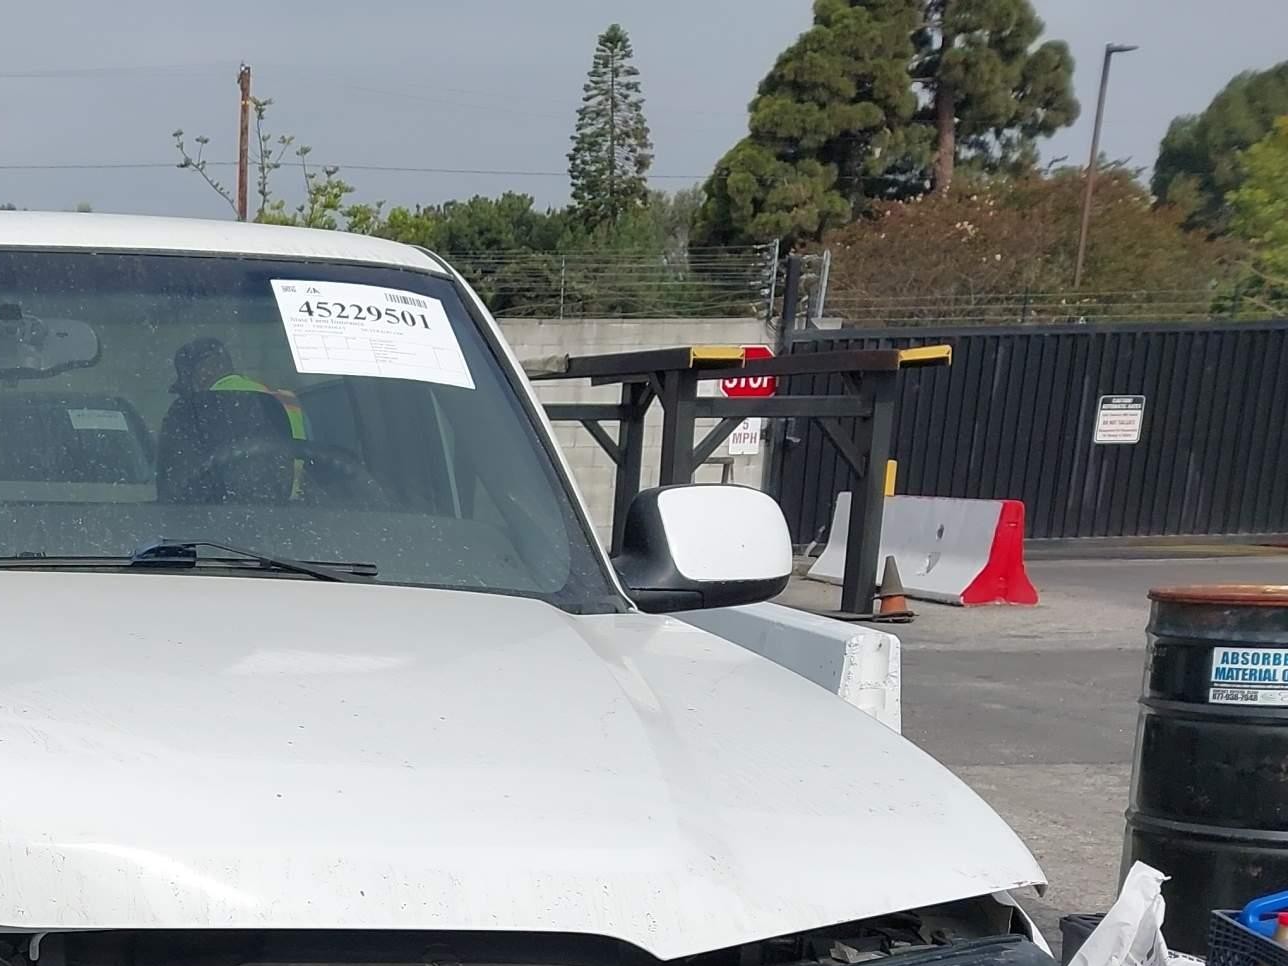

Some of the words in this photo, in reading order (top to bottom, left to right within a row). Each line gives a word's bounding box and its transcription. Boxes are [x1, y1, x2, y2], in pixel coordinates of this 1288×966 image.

[298, 300, 431, 330] 45229501
[732, 431, 758, 444] MPH
[1214, 666, 1278, 682] MATERIAL
